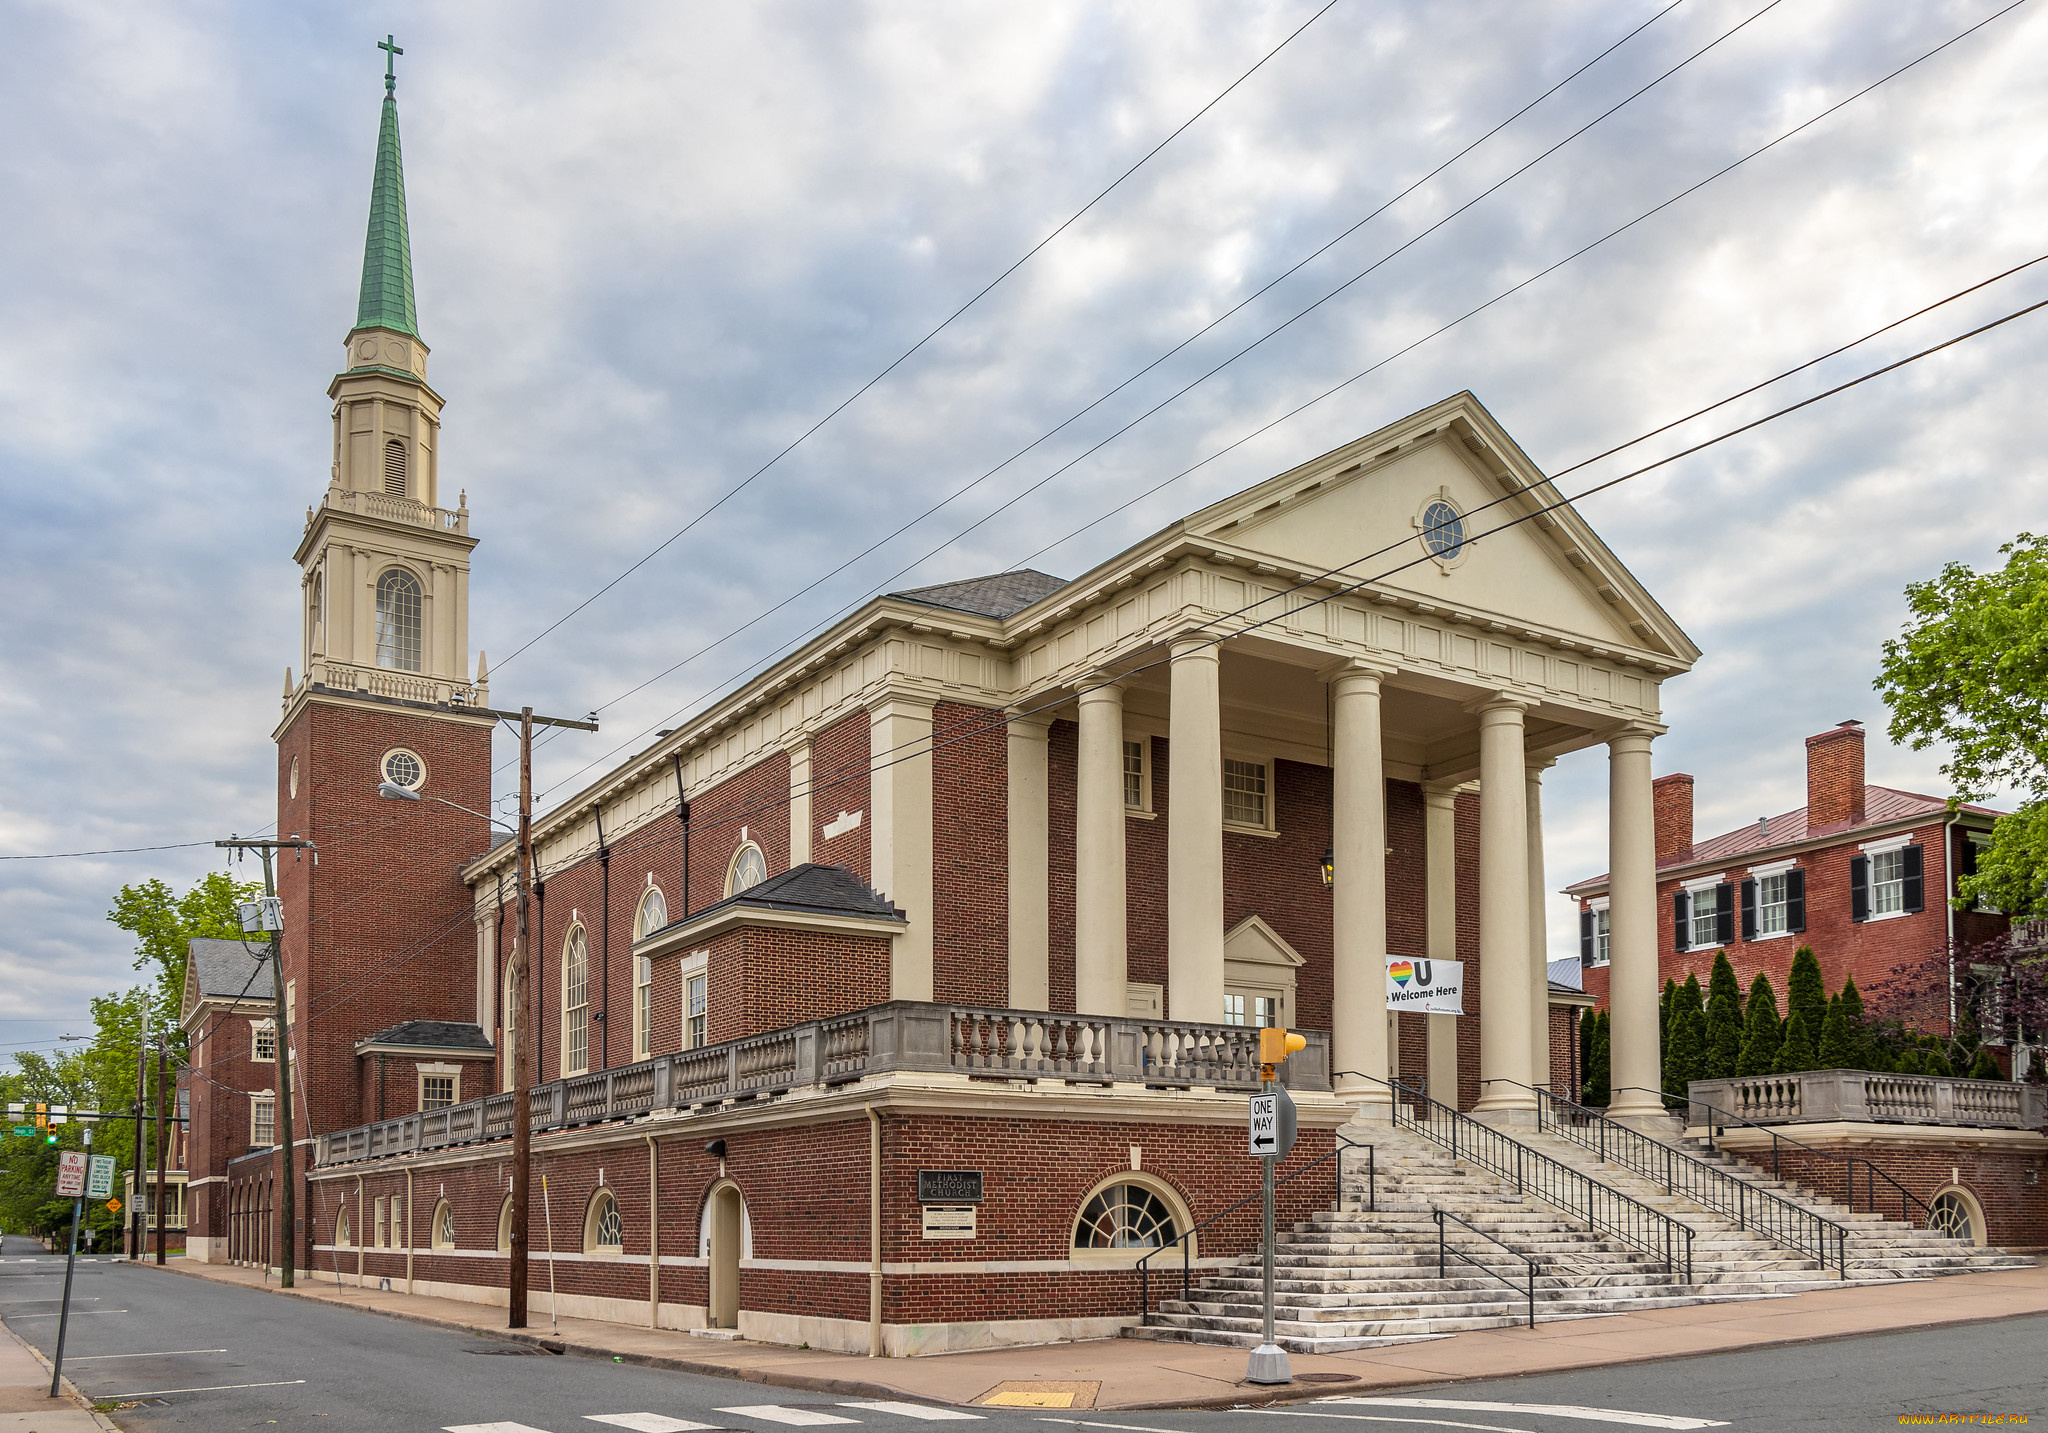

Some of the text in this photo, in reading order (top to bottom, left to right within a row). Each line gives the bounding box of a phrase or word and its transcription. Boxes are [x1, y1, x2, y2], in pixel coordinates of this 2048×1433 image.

[1414, 960, 1432, 986] U
[1391, 989, 1433, 1002] Welcome
[1436, 986, 1457, 996] Here
[1254, 1100, 1272, 1114] ONE
[1253, 1116, 1273, 1131] WAY
[69, 1155, 78, 1164] NO
[62, 1164, 84, 1174] PARKING
[937, 1173, 964, 1181] FIRST
[924, 1180, 977, 1189] METHODIST
